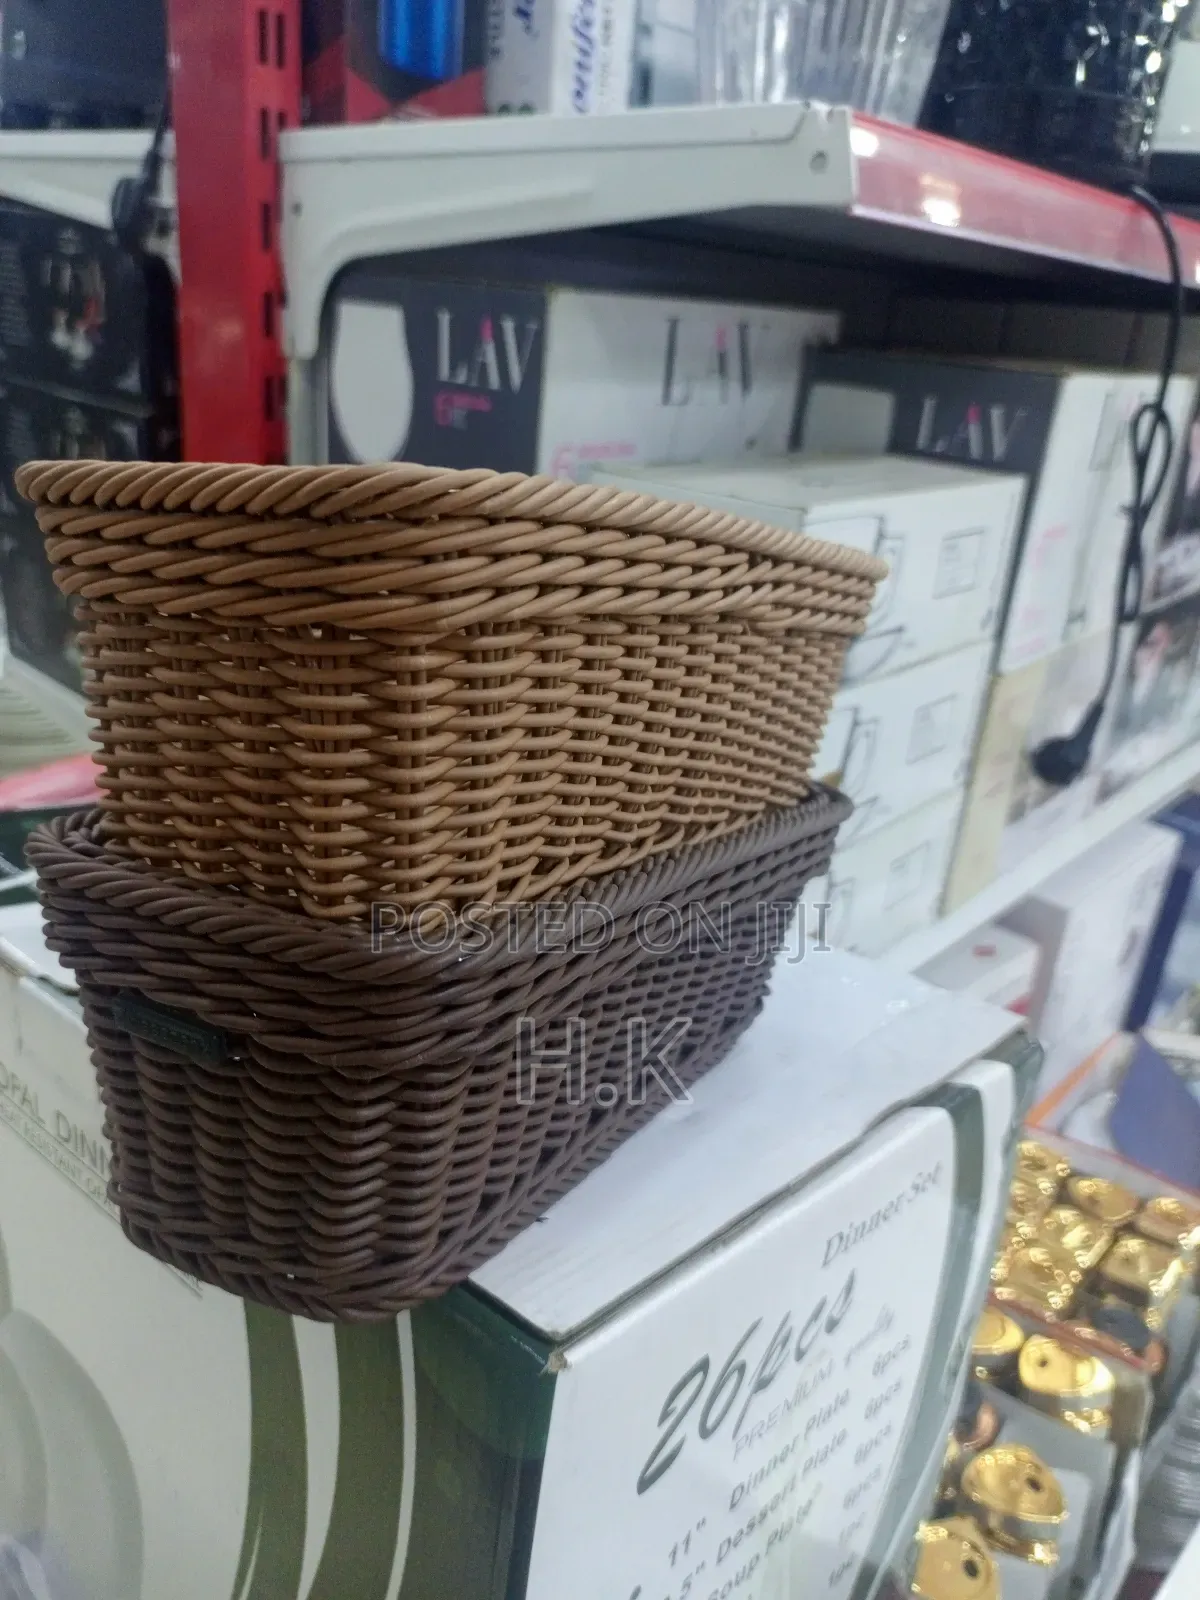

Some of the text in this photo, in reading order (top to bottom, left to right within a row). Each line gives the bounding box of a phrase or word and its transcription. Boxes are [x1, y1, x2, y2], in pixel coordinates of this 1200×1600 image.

[434, 308, 538, 394] LAV
[916, 395, 1030, 462] LAV
[821, 1160, 944, 1269] Dinner Set
[636, 1267, 857, 1496] 26pcs
[732, 1358, 833, 1463] PREMIUM
[715, 1474, 796, 1567] Dessert
[802, 1426, 848, 1479] Plate
[728, 1433, 800, 1512] Dinner
[803, 1386, 850, 1441] Plate
